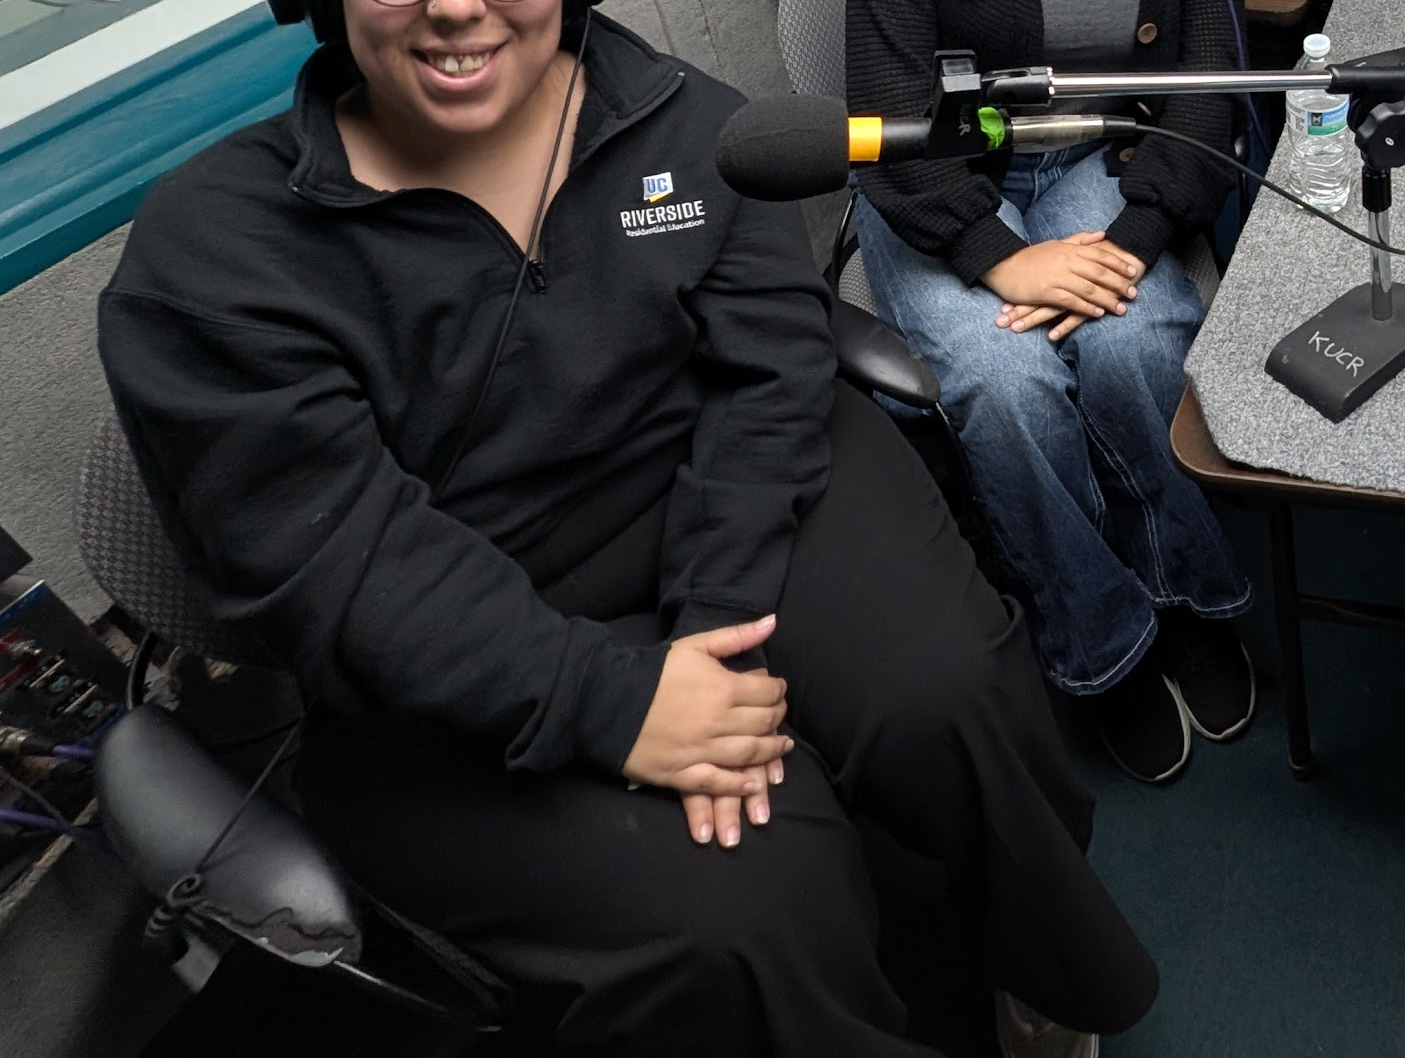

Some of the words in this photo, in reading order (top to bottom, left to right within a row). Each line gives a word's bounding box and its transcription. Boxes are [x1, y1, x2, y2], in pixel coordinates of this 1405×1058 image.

[646, 177, 668, 193] UC
[620, 200, 706, 228] RIVERSIDE
[625, 224, 666, 237] Residential
[667, 218, 705, 232] Education
[1308, 331, 1364, 377] KUCR
